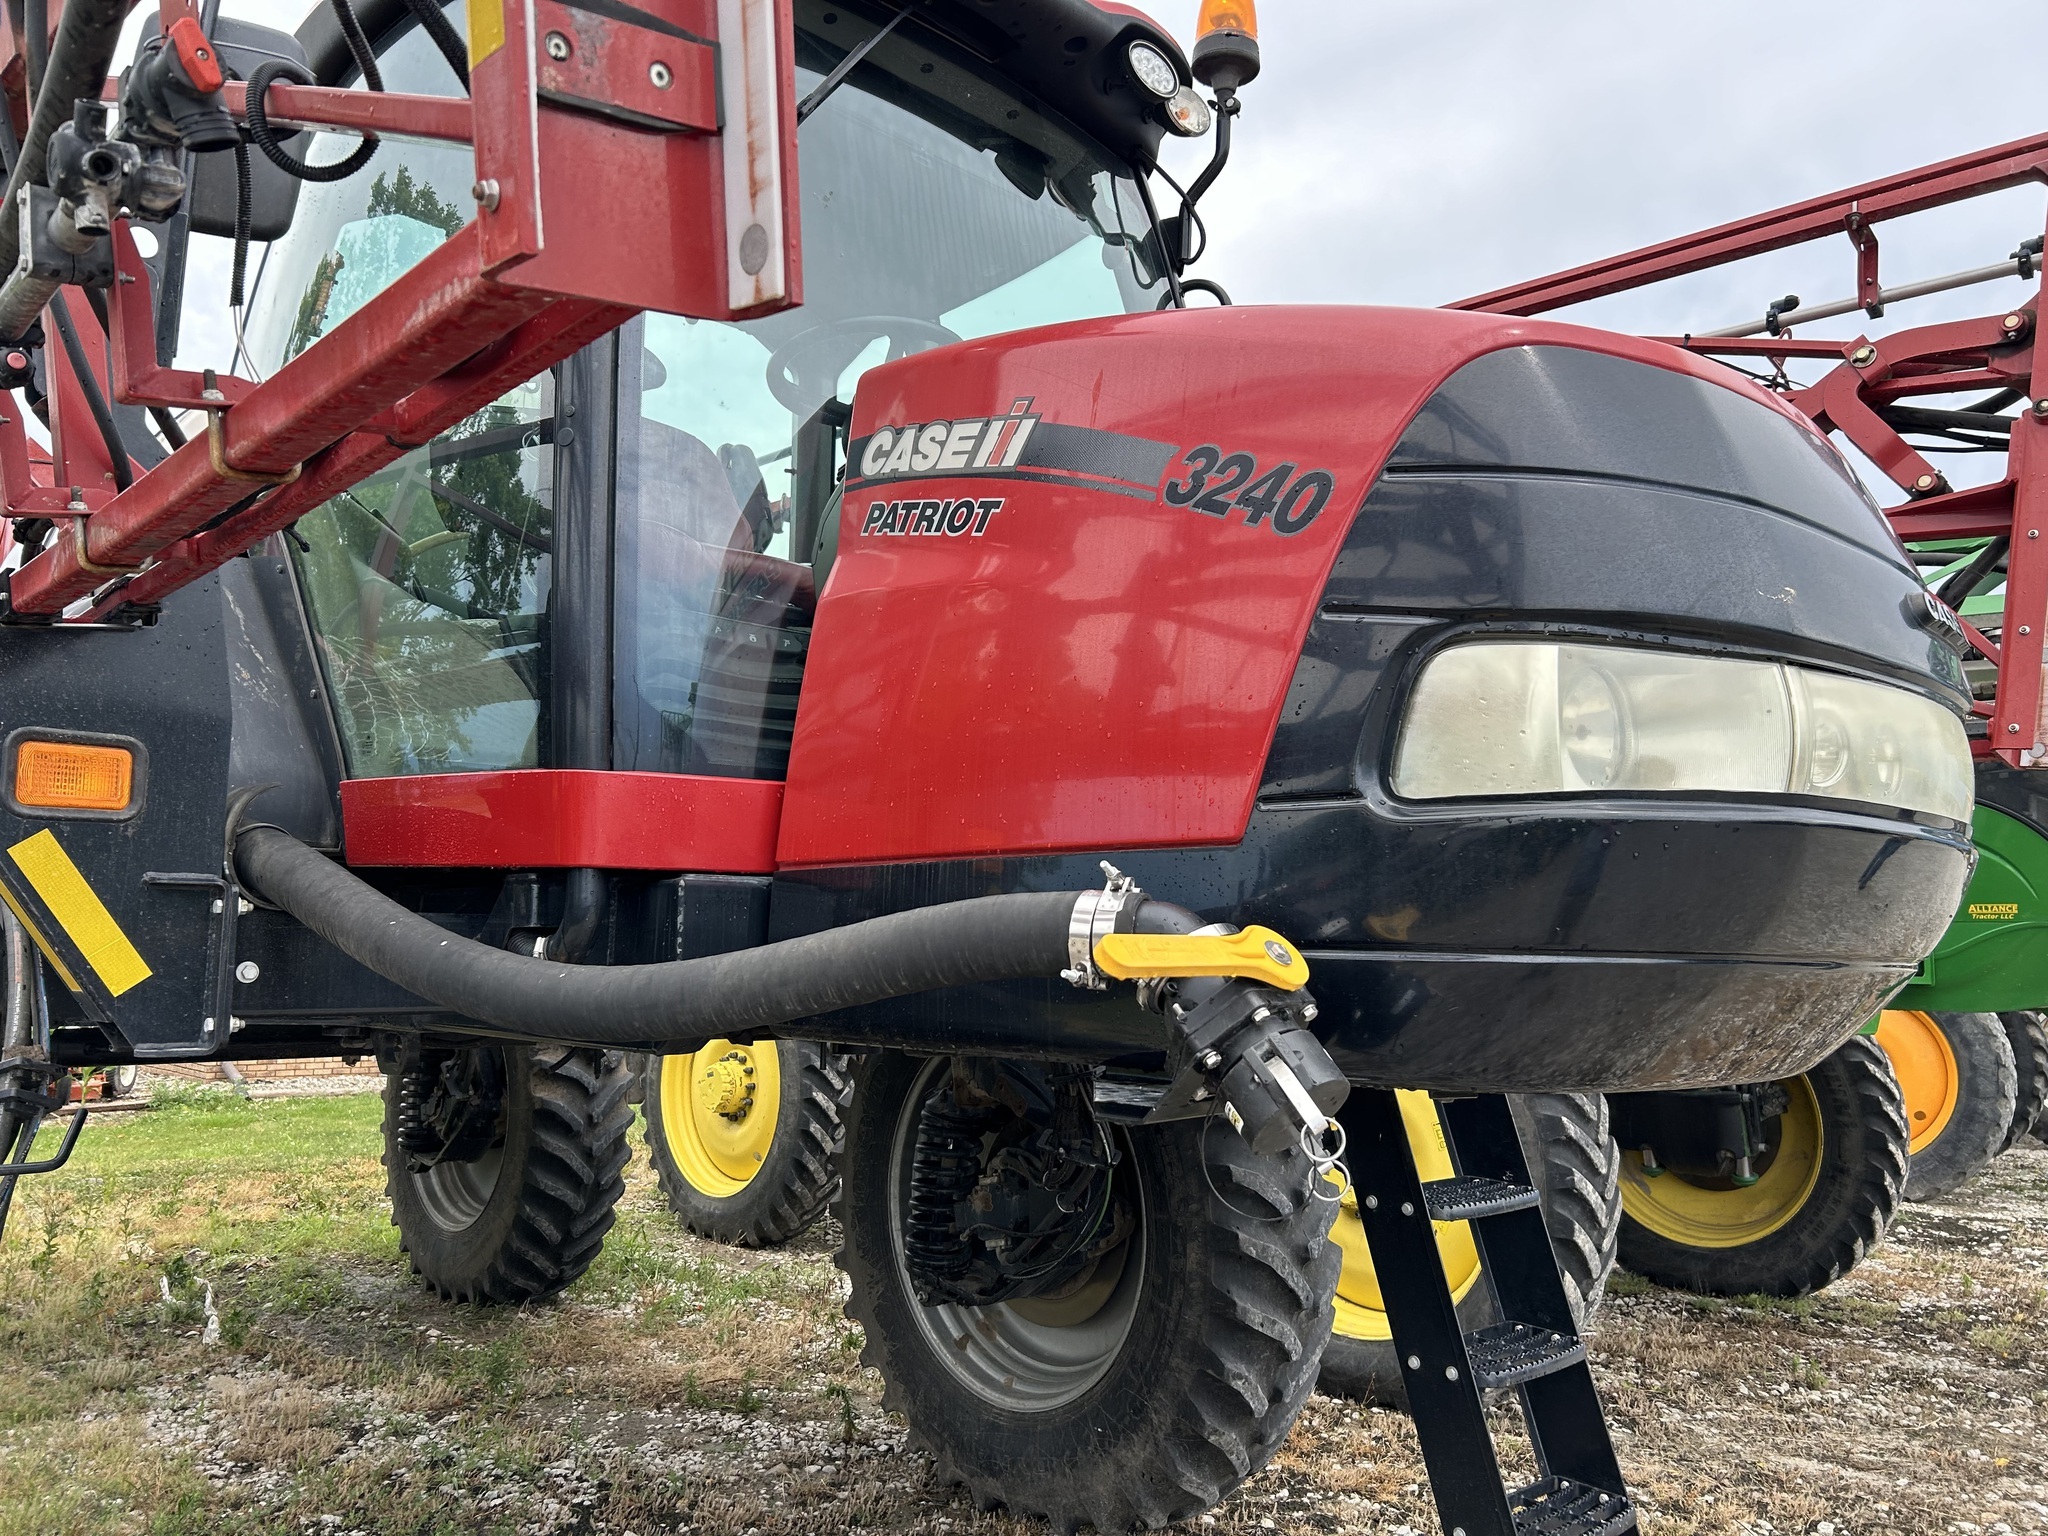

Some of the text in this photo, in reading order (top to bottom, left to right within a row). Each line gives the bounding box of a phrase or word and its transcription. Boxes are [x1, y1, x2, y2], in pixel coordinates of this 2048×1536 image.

[1165, 444, 1336, 537] 3240
[861, 497, 1005, 537] PATRIOT
[1968, 904, 2018, 913] ALLIANCE
